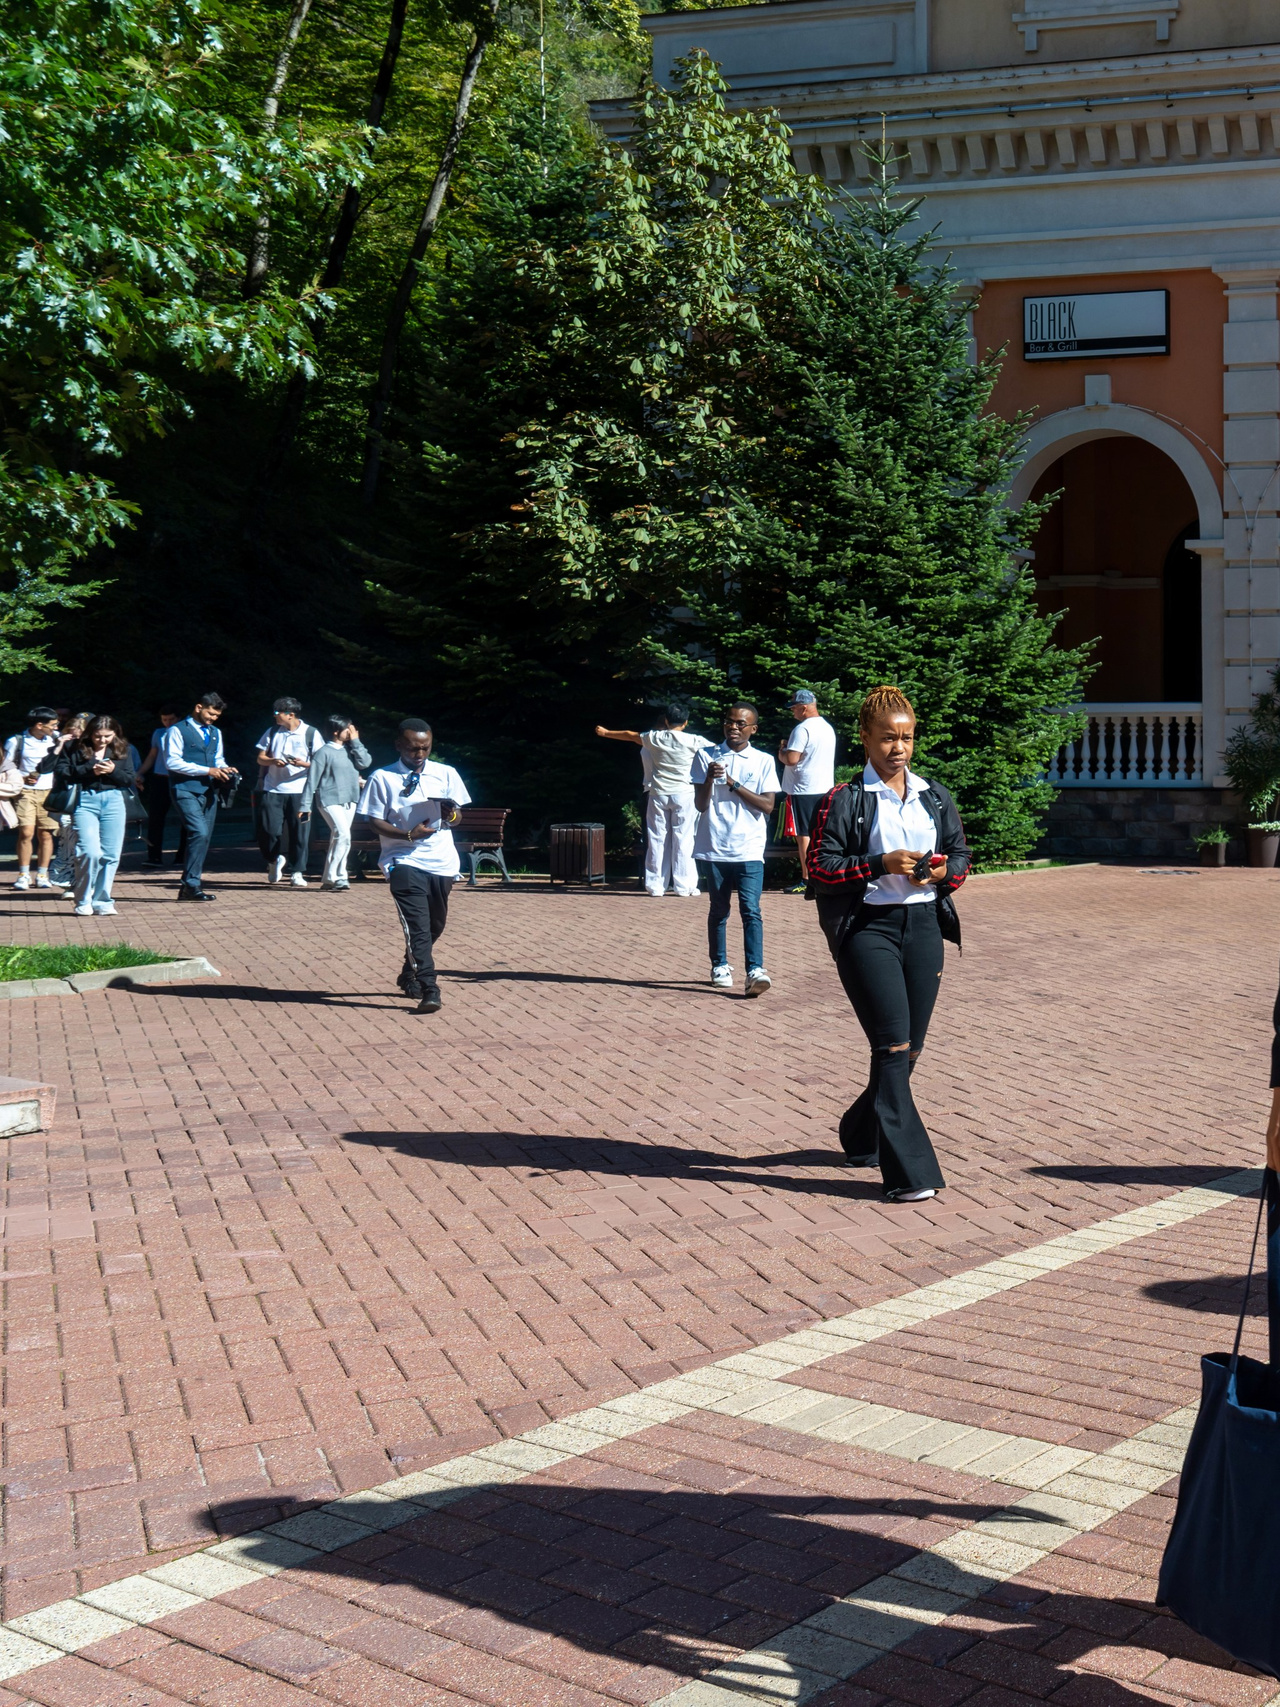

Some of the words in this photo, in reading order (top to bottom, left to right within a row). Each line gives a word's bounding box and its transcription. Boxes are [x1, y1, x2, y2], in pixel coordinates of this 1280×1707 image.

[1030, 301, 1077, 340] BLACK
[1029, 343, 1045, 353] Bar
[1047, 342, 1054, 351] &
[1057, 341, 1078, 352] Grill
